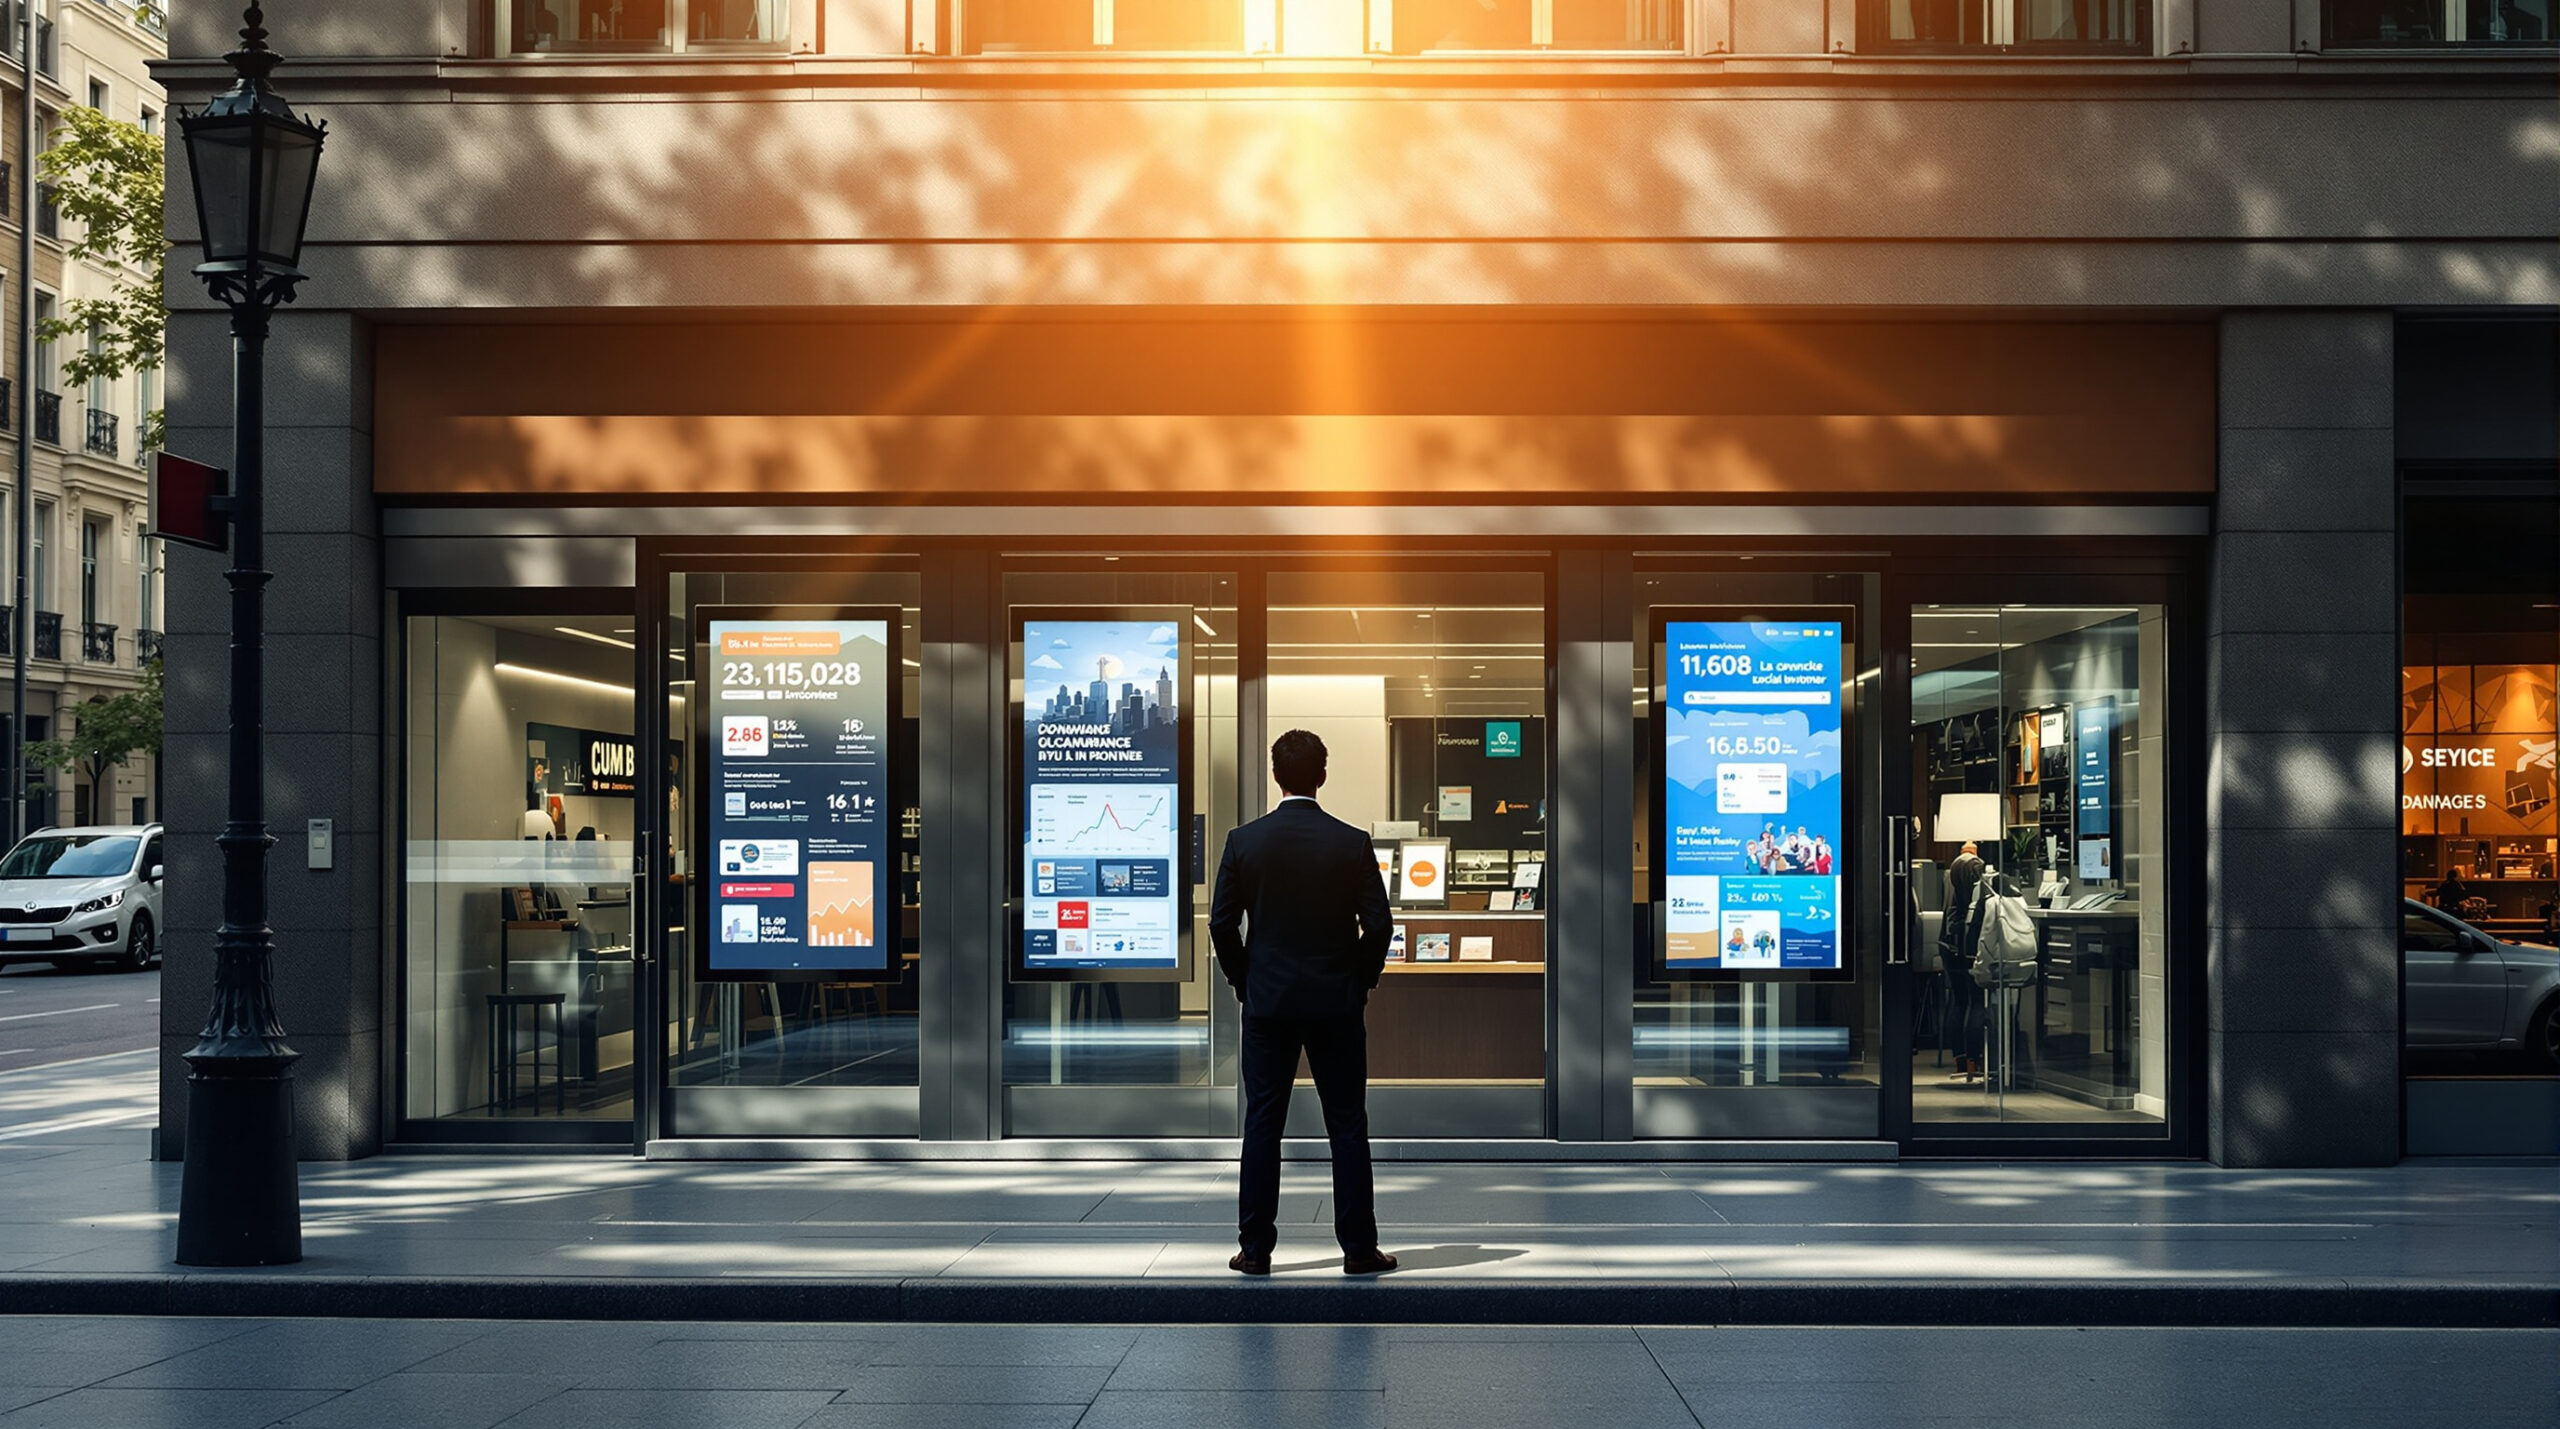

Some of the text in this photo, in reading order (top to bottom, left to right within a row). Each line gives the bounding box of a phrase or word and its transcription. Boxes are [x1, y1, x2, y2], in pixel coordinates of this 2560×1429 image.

[722, 662, 861, 689] 23,115,028
[1679, 654, 1752, 677] 11,608
[591, 741, 623, 776] CUM
[2421, 748, 2496, 767] SEYICE
